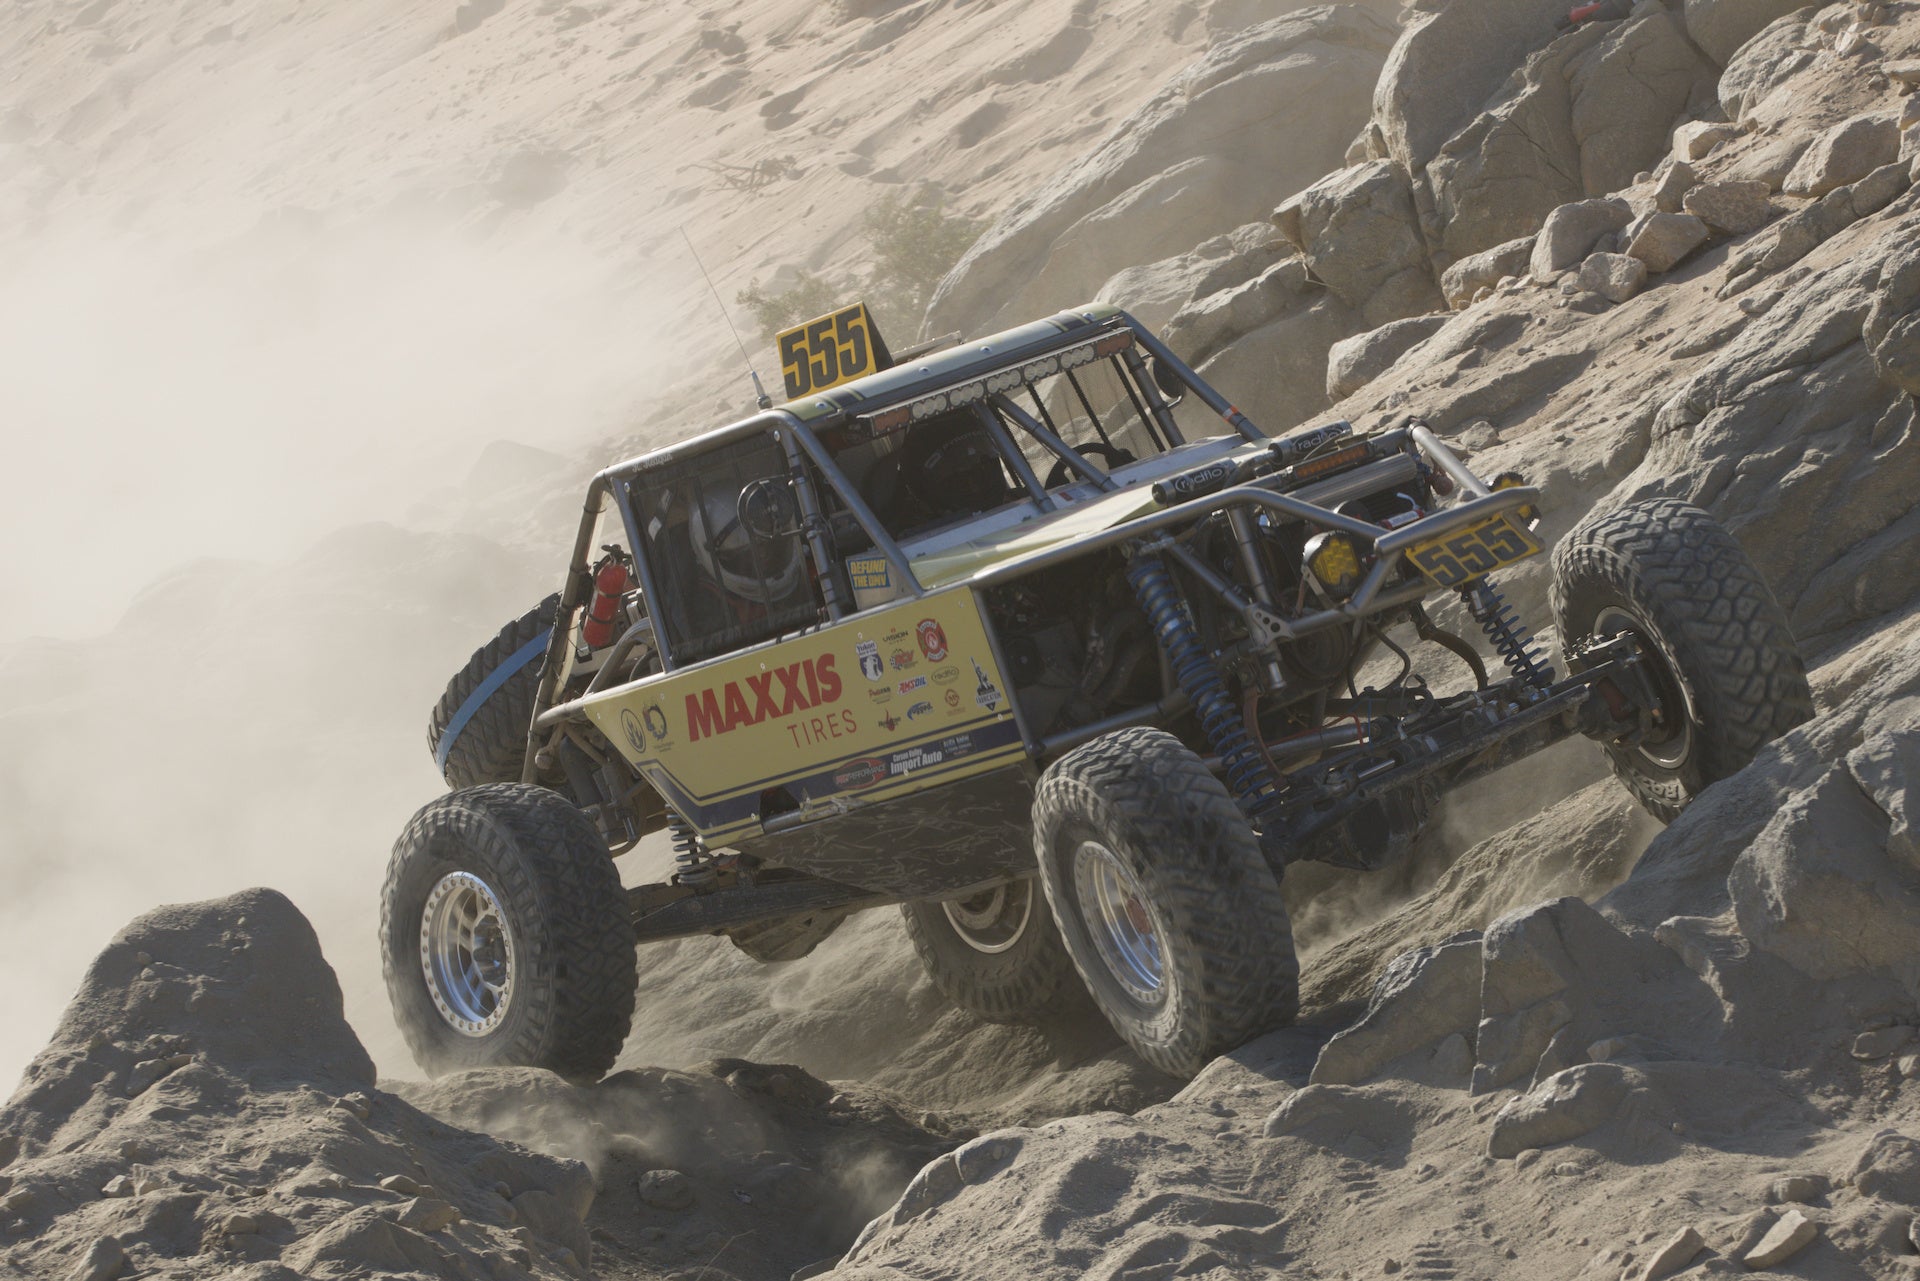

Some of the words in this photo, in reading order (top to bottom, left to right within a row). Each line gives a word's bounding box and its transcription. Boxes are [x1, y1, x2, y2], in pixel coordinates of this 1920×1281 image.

[780, 306, 868, 399] 555
[1180, 467, 1223, 488] radflo
[1414, 517, 1529, 586] 555
[850, 559, 886, 574] DEFUND
[853, 575, 867, 587] THE
[868, 574, 887, 587] DMV
[857, 641, 876, 652] Yukon
[899, 676, 926, 694] AMSOIL
[685, 653, 842, 742] MAXXIS
[787, 709, 857, 748] TIRES
[890, 755, 921, 775] Import
[922, 751, 943, 766] Auto
